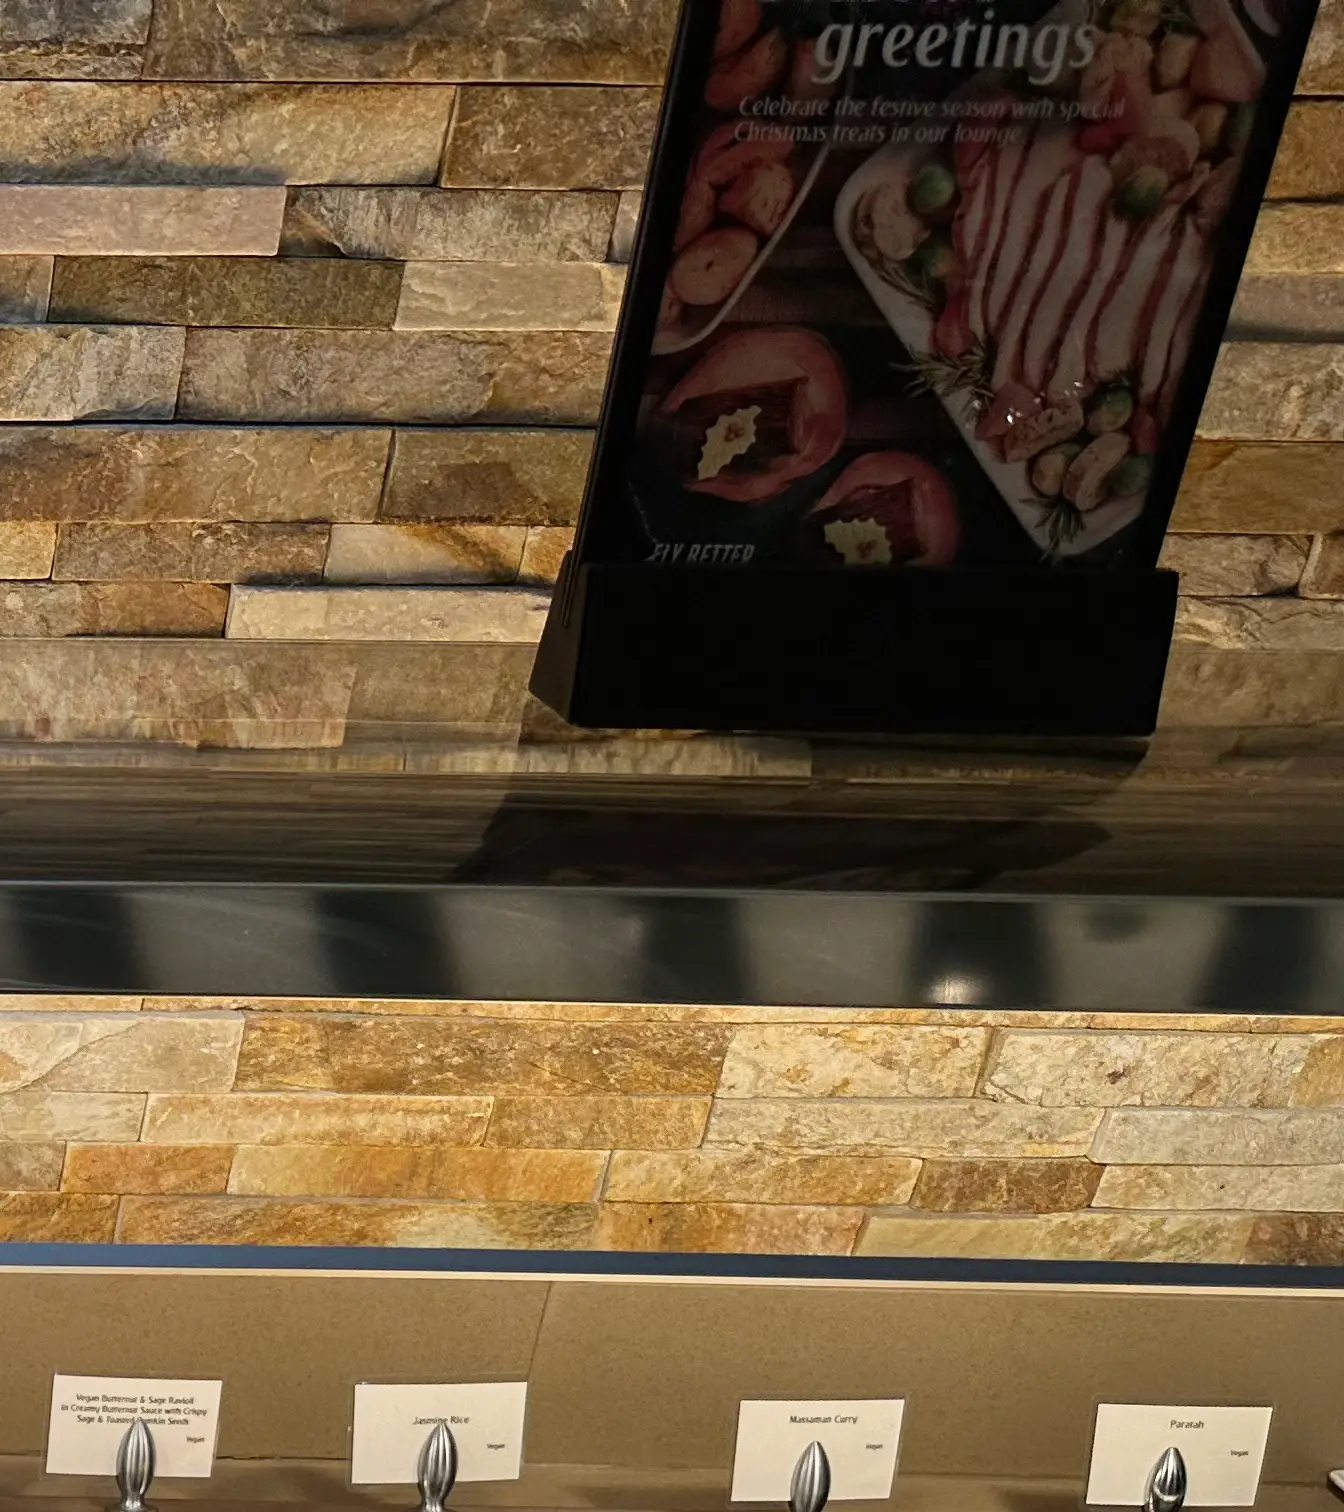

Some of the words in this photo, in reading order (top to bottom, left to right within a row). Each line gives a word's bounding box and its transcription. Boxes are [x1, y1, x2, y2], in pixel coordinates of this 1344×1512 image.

[810, 9, 1098, 87] greetings
[739, 96, 830, 117] Celebrate
[835, 96, 864, 117] the
[868, 96, 936, 120] festive
[941, 102, 1006, 118] season
[1011, 97, 1053, 118] with
[733, 121, 827, 143] Christmas
[831, 123, 885, 143] treats
[890, 123, 910, 143] in
[915, 127, 947, 143] our
[953, 123, 1022, 146] lounge
[140, 1396, 146, 1404] &
[412, 1416, 449, 1425] Jasmine
[450, 1416, 470, 1424] Rice
[789, 1415, 832, 1424] Massaman
[834, 1415, 858, 1425] Curry
